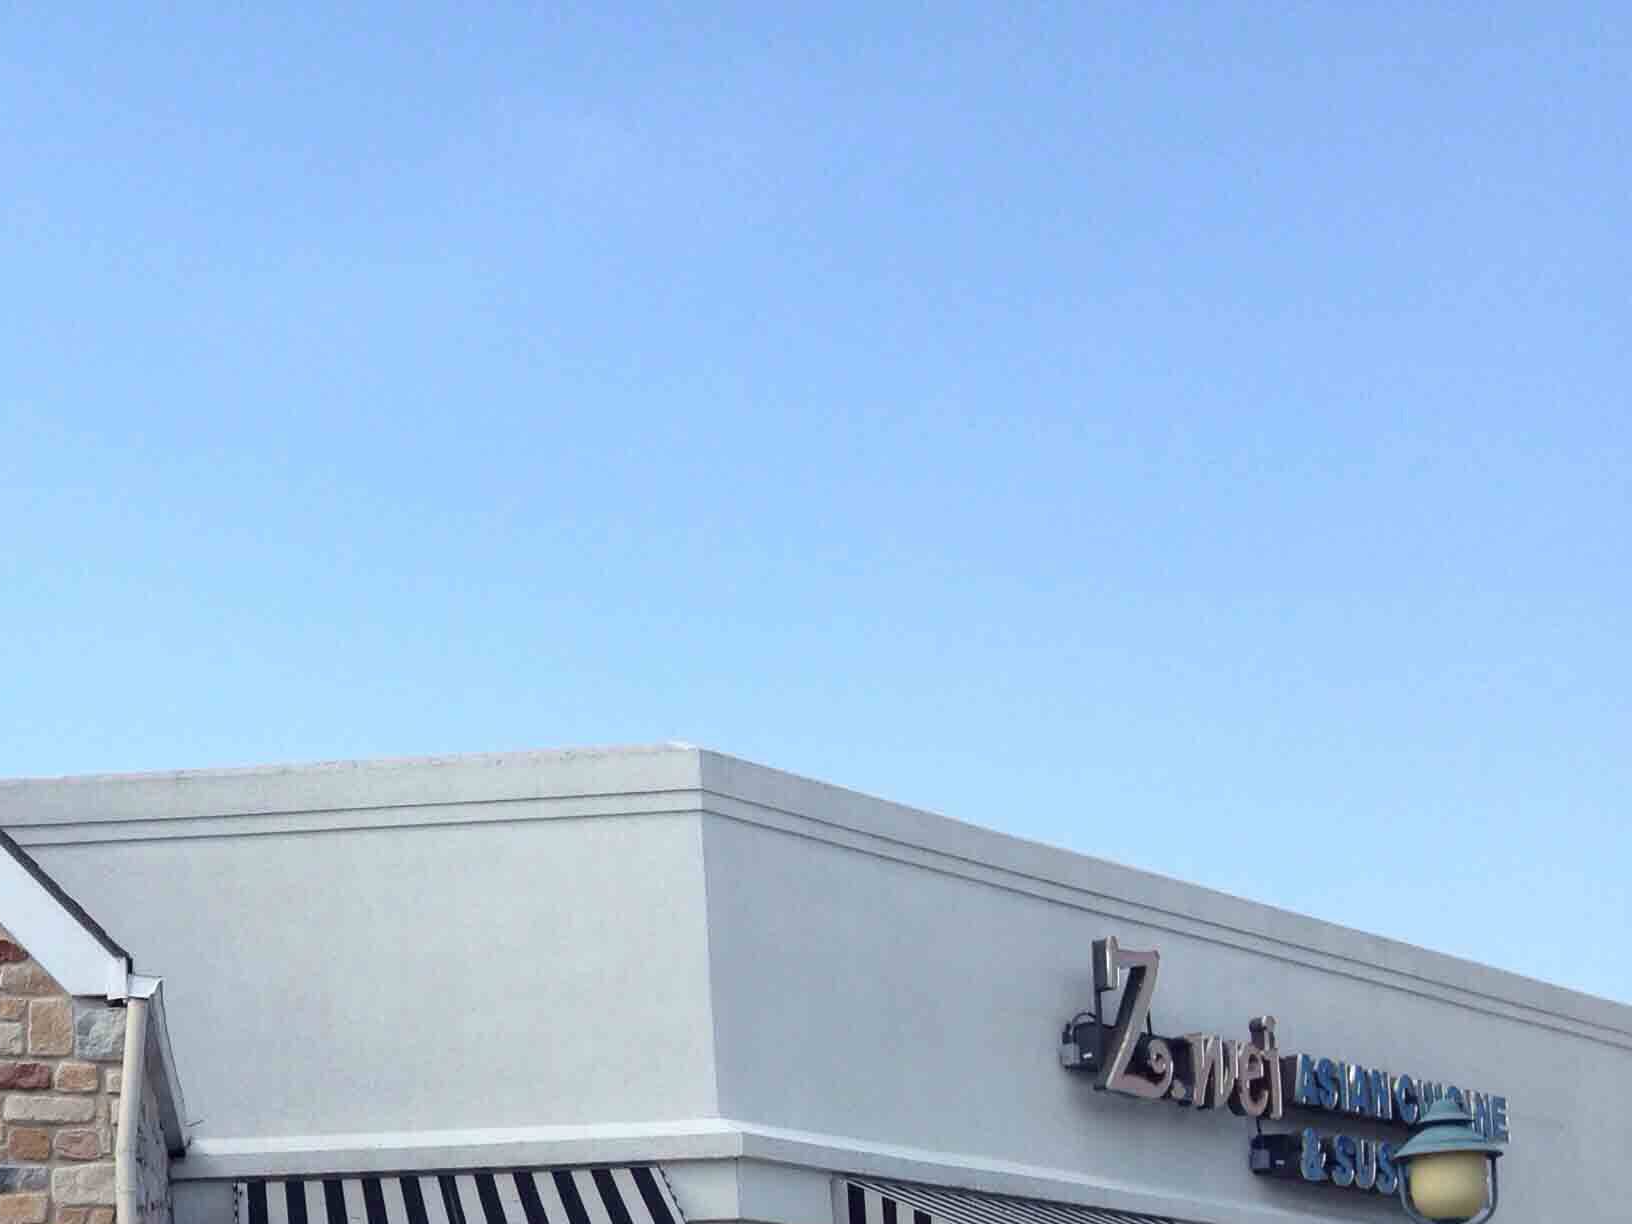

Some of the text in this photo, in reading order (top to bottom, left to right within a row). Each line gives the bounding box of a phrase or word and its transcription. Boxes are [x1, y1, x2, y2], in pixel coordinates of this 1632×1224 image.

[1295, 1053, 1393, 1121] ASIAN
[1300, 1128, 1399, 1195] & SUS
